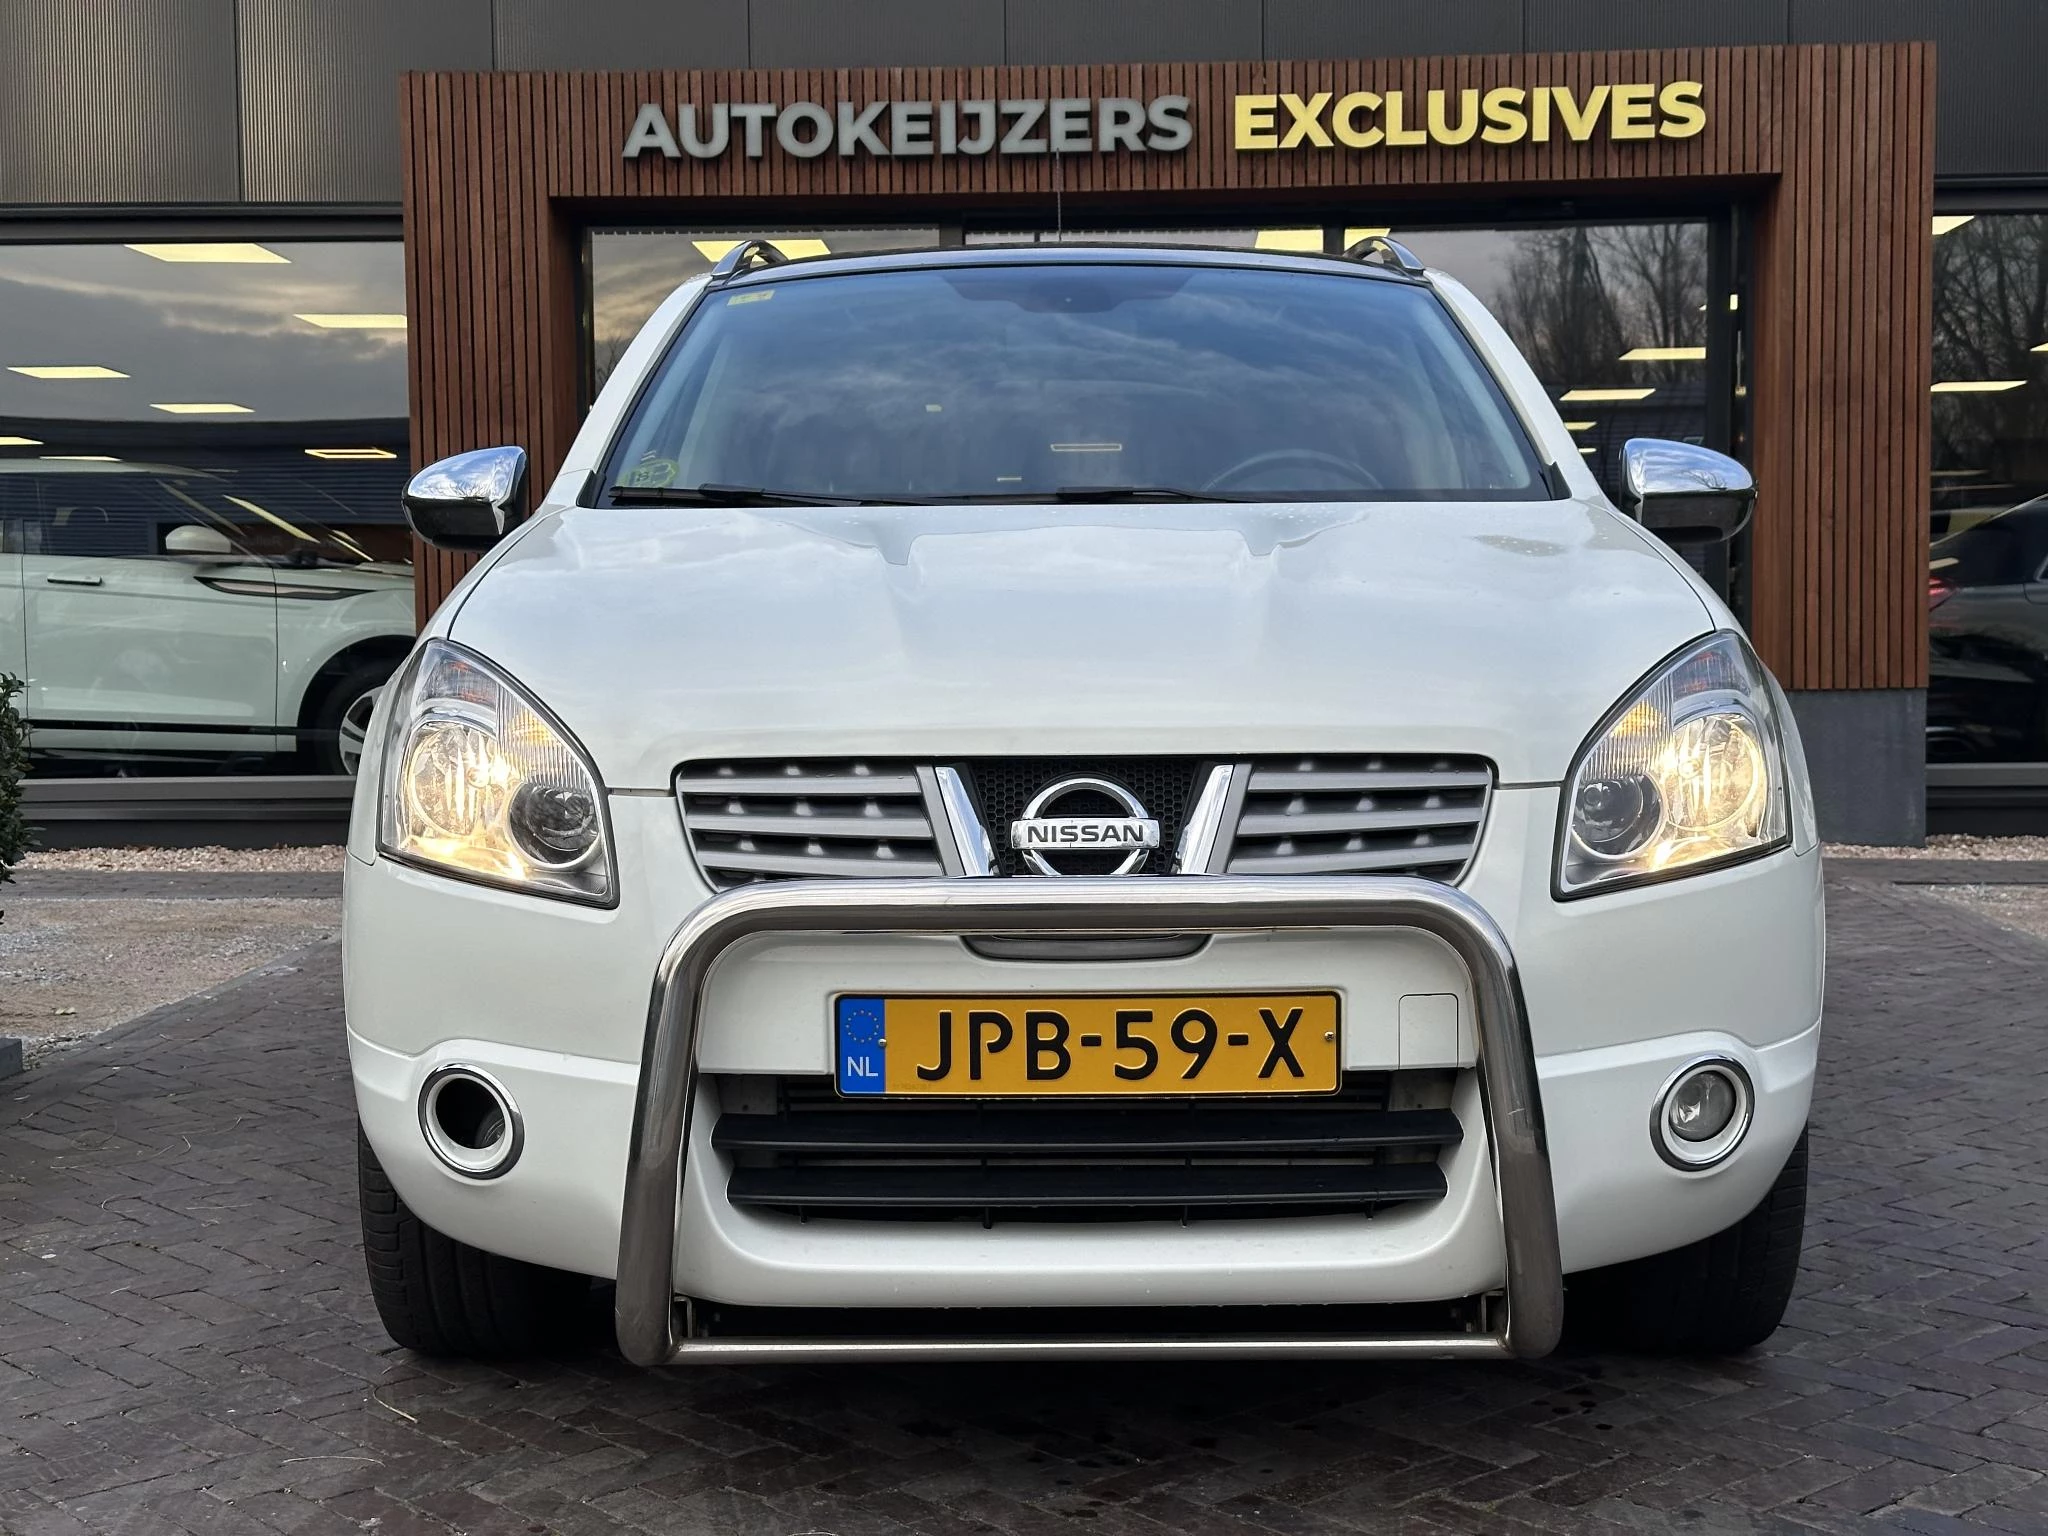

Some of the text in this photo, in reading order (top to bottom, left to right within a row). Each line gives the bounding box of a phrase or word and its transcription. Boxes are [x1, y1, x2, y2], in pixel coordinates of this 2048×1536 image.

[622, 81, 1707, 158] AUTOKEIJZERS EXCLUSIVES
[1027, 824, 1144, 843] NISSAN
[846, 1056, 879, 1077] NL
[916, 1007, 1305, 1081] JPB-59-X
